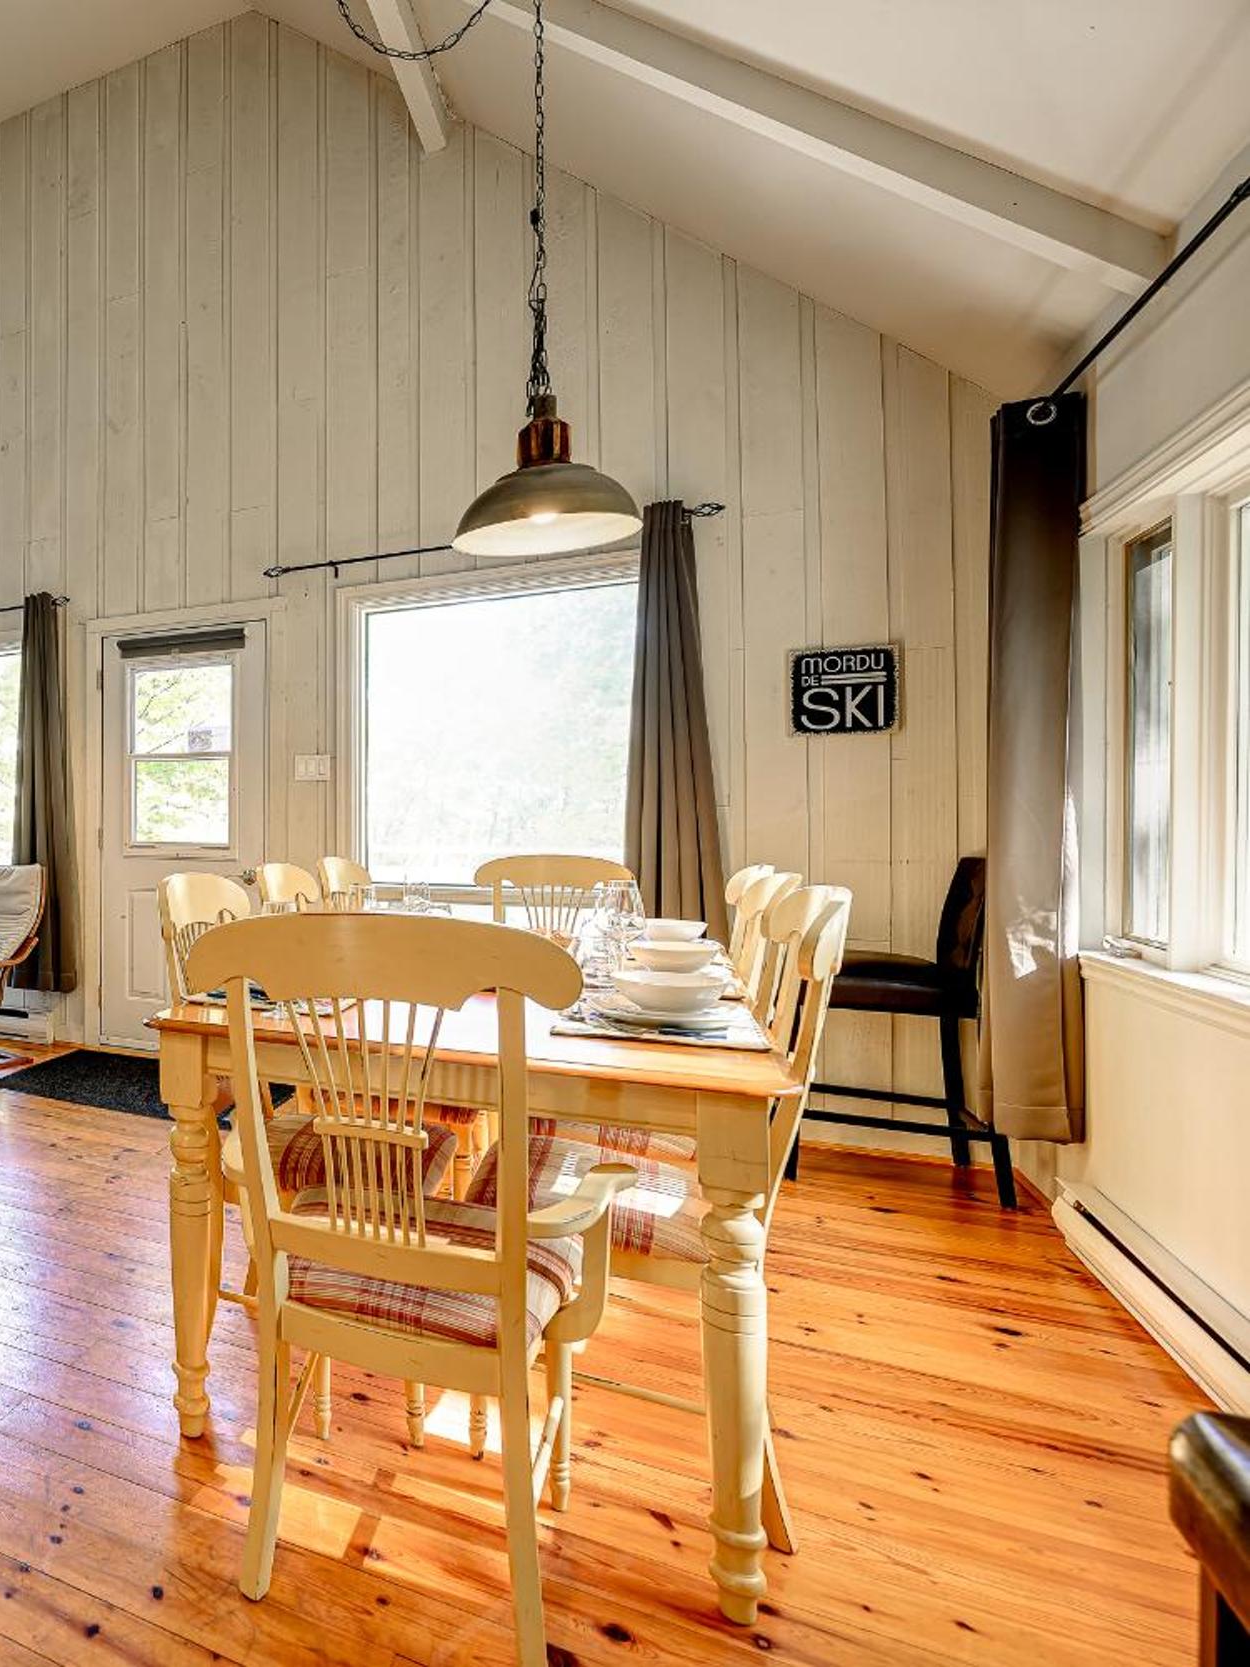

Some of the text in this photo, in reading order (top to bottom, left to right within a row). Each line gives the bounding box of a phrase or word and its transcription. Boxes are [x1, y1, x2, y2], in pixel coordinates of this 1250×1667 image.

[800, 652, 885, 675] MORDU
[800, 674, 820, 688] DE
[800, 684, 885, 730] SKI
